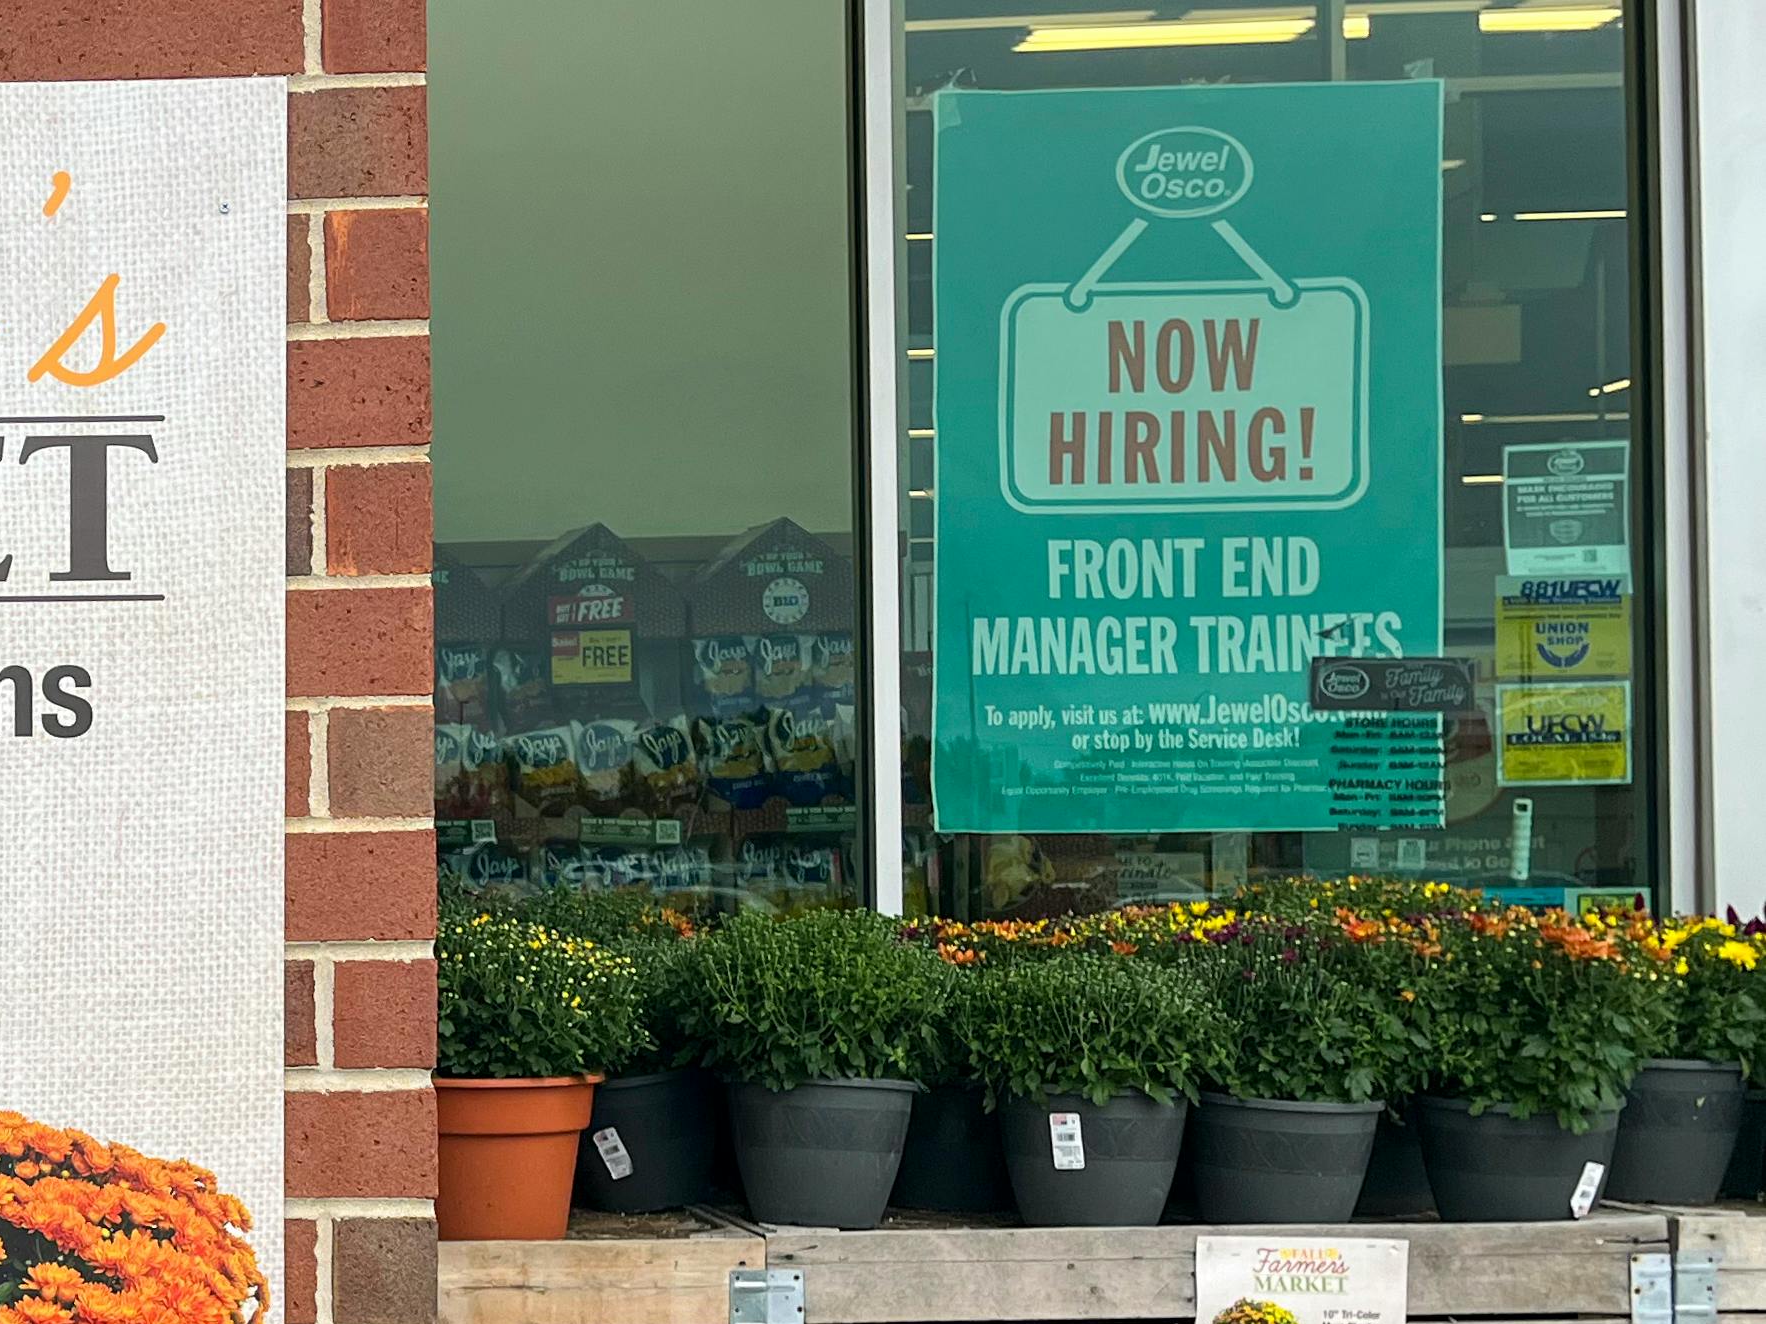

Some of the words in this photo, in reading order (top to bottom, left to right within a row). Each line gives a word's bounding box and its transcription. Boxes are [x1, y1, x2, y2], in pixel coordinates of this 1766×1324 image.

[1135, 144, 1230, 172] Jewel
[1140, 173, 1225, 199] Osco
[1108, 317, 1260, 394] NOW
[1049, 407, 1315, 485] HIRING!
[1517, 494, 1536, 503] FOR
[1538, 493, 1553, 502] ALL
[599, 567, 634, 581] GAME
[787, 560, 824, 574] GAME
[1047, 537, 1204, 599] FRONT
[1222, 536, 1320, 597] END
[577, 597, 624, 622] FREE
[1535, 622, 1589, 634] UNION
[1547, 635, 1584, 646] SHOP
[972, 615, 1178, 675] MANAGER
[1190, 611, 1403, 673] TRAINEES
[582, 646, 629, 667] FREE
[985, 705, 1003, 726] To
[1008, 705, 1056, 730] apply,
[1062, 704, 1095, 725] visit
[1099, 709, 1118, 725] us
[1072, 734, 1090, 749] or
[1094, 729, 1130, 753] stop
[1135, 729, 1153, 753] by
[1158, 729, 1183, 749] the
[1188, 727, 1248, 749] Service
[1254, 726, 1300, 748] Desk!
[1328, 778, 1403, 789] PHARMACY
[1252, 1248, 1350, 1274] Farmer's
[1254, 1275, 1348, 1294] MARKET
[1341, 1309, 1380, 1320] Tri-Color
